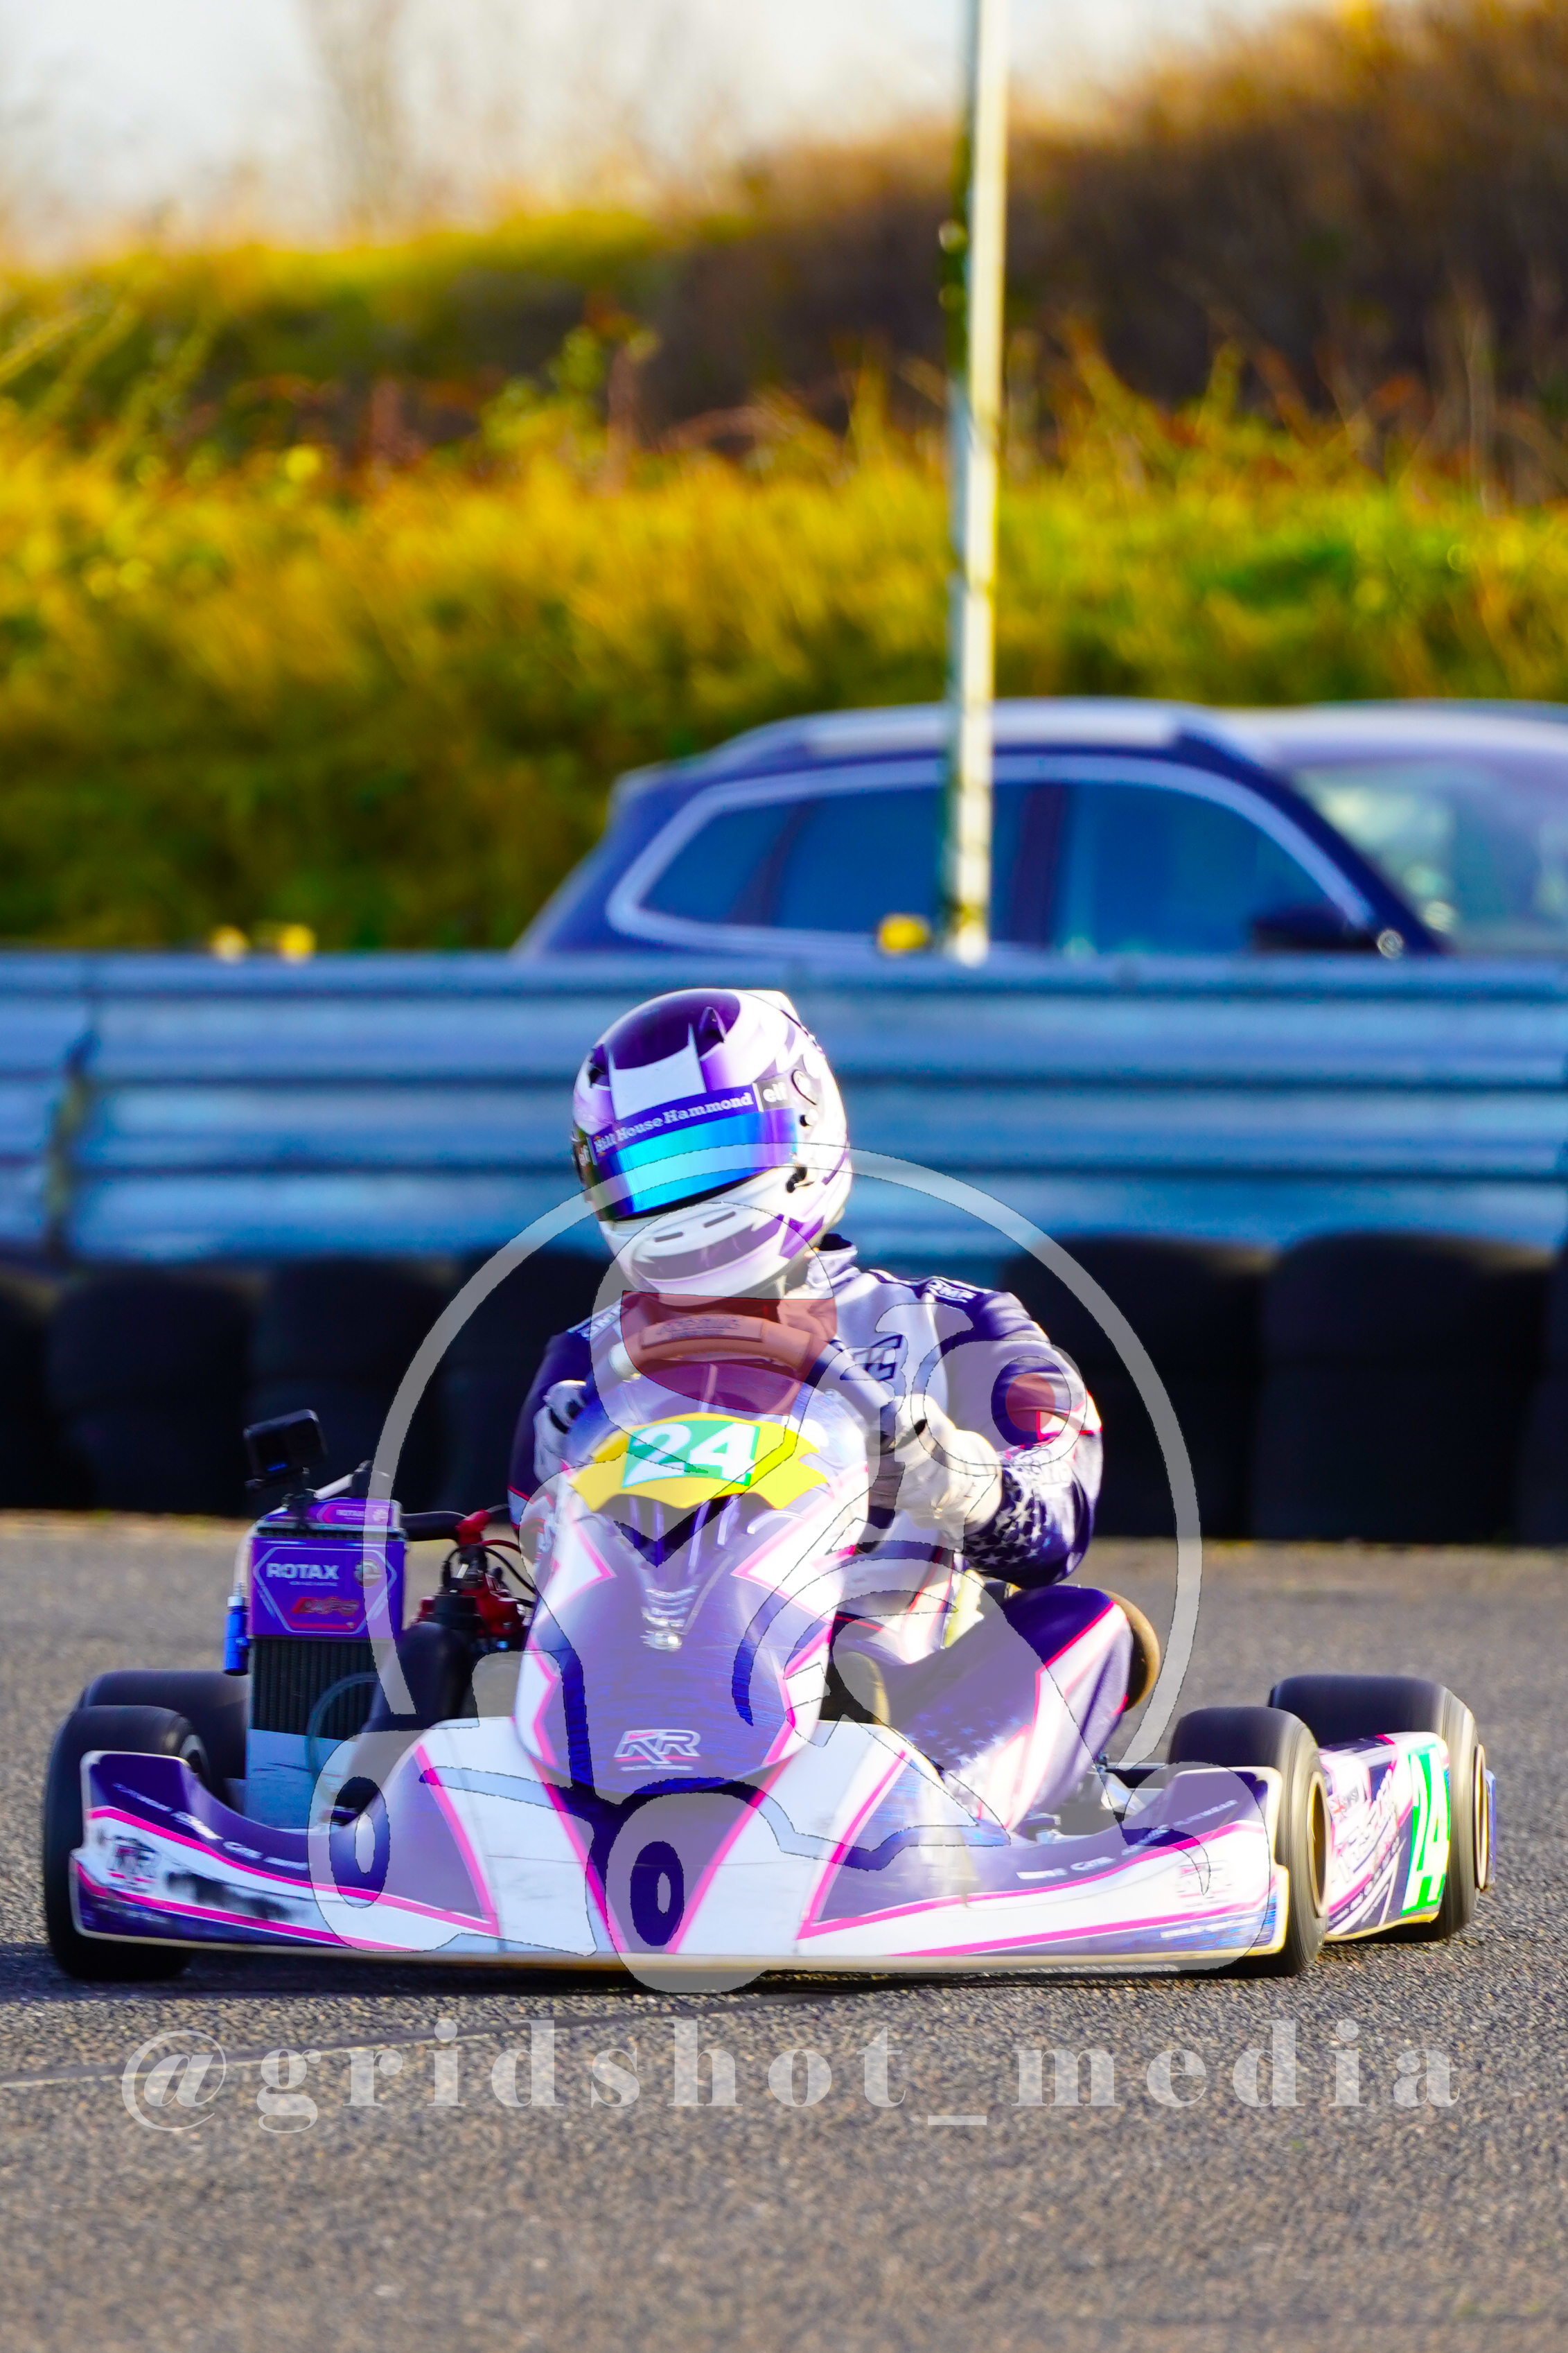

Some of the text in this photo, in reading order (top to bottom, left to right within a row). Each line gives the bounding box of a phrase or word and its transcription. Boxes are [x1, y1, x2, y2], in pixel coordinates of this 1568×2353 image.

[762, 1081, 789, 1103] elf
[617, 1117, 664, 1143] House
[662, 1092, 754, 1124] Hammond
[624, 1422, 755, 1486] 24
[266, 1563, 340, 1580] ROTAX
